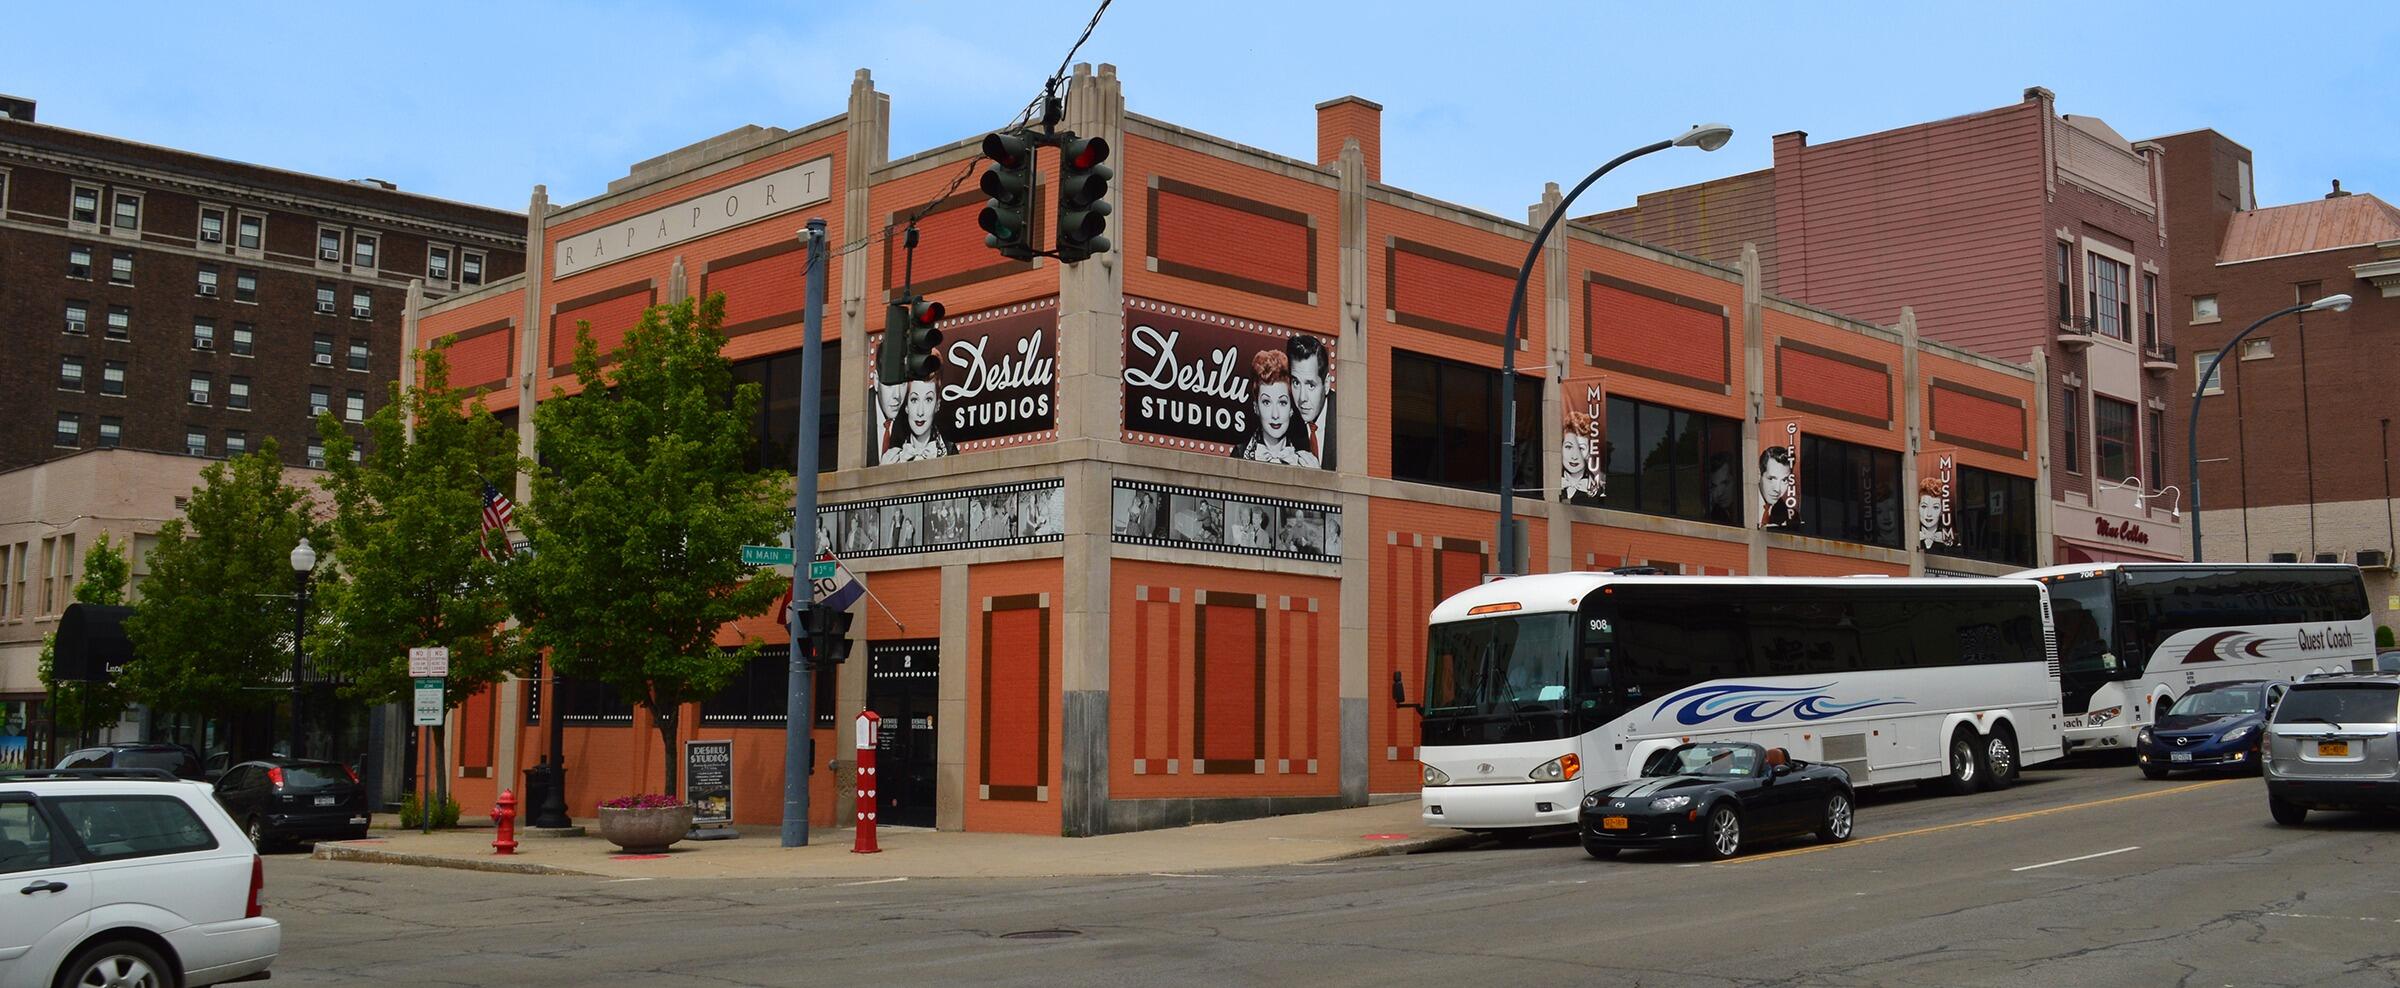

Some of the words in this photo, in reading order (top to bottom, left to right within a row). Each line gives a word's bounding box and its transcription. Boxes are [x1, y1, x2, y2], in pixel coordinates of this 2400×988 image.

[565, 170, 815, 266] RAPAPORT
[941, 328, 1053, 402] Desilu
[1123, 325, 1250, 404] Desilu
[954, 393, 1050, 430] STUDIOS
[1141, 395, 1246, 433] STUDIOS
[1586, 384, 1601, 491] MUSEUM
[1786, 422, 1797, 469] GIFT
[1785, 473, 1797, 520] SHOP
[1939, 454, 1955, 541] MUSEUM
[2095, 516, 2120, 539] Wine
[2120, 520, 2150, 545] Cellar
[746, 549, 753, 559] N
[755, 549, 779, 560] MAIN
[1590, 619, 1608, 630] 908
[2298, 628, 2325, 651] Quest
[2326, 624, 2353, 649] Coach
[904, 654, 912, 668] 2
[690, 754, 729, 764] STUDIOS
[693, 746, 726, 755] DESILU
